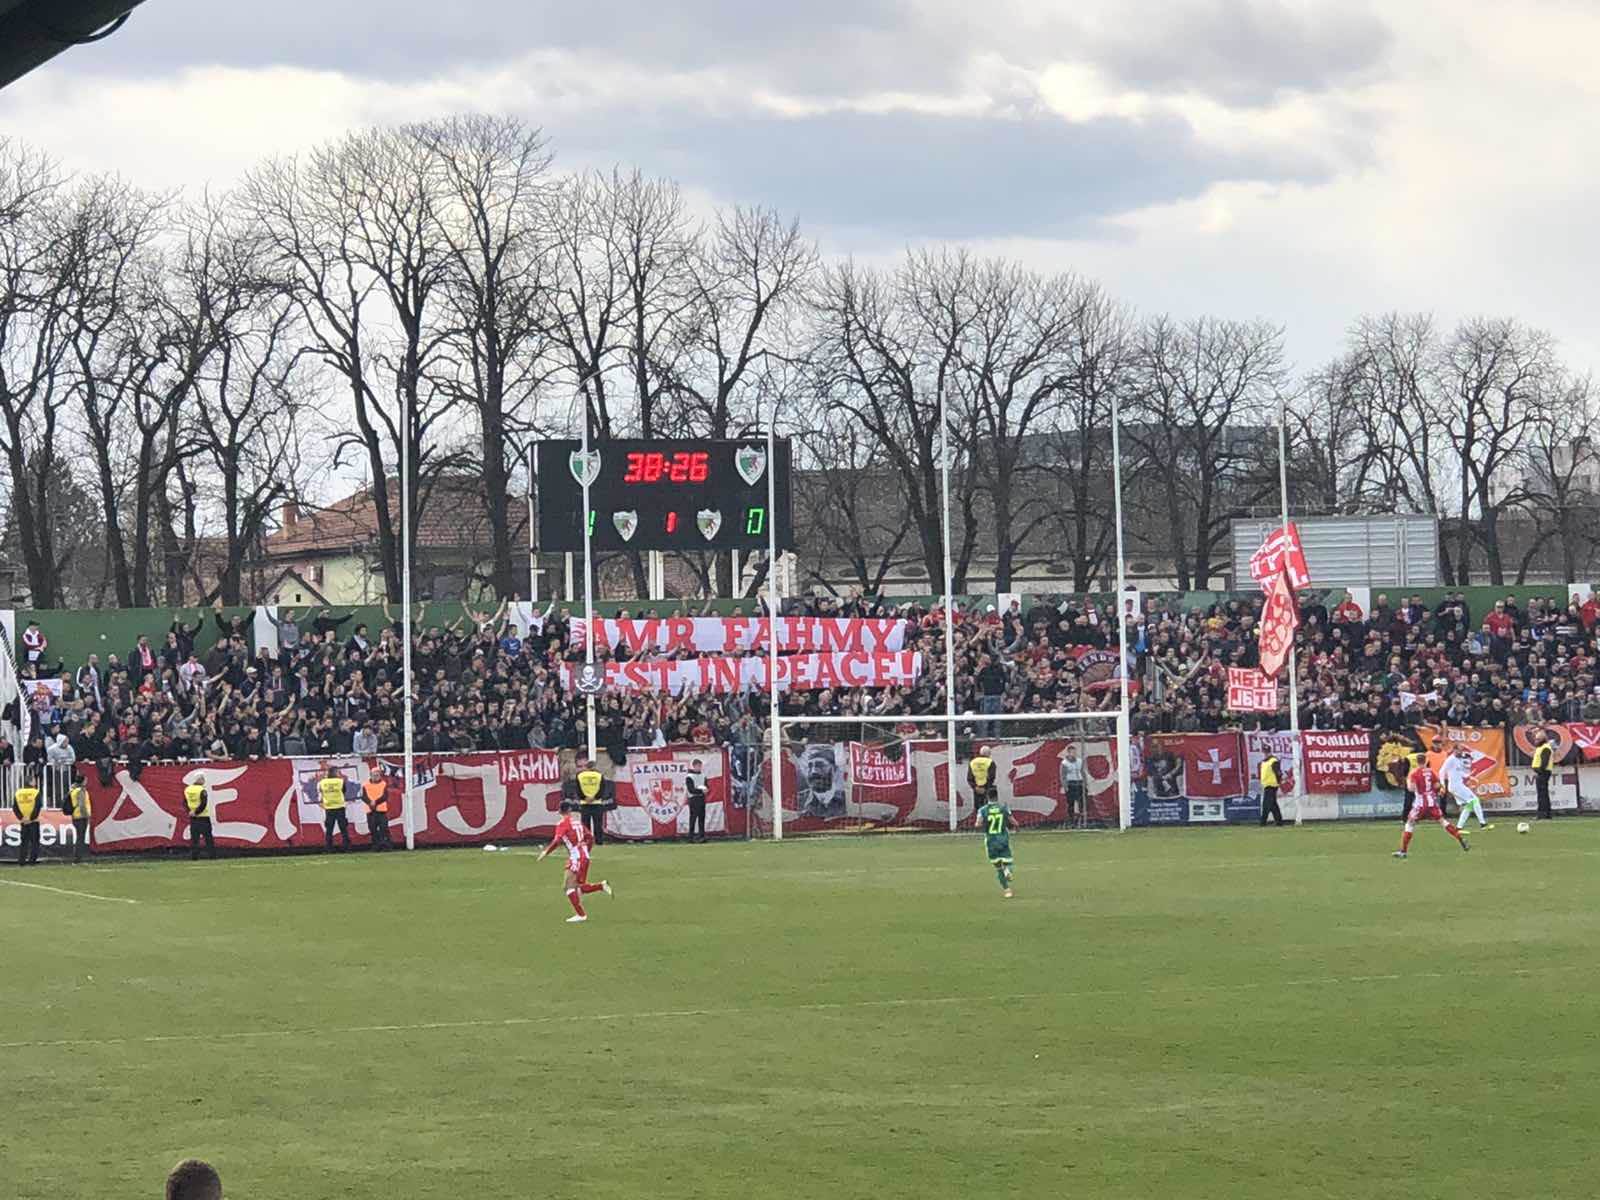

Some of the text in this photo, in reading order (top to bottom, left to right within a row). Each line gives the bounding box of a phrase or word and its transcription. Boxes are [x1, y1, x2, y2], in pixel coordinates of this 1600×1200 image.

[624, 452, 709, 483] 38:26
[666, 511, 678, 534] 1
[747, 508, 764, 534] 0
[591, 617, 897, 651] AMR FAHMY
[566, 651, 915, 694] EST IN PEACE!
[987, 814, 1004, 834] 27
